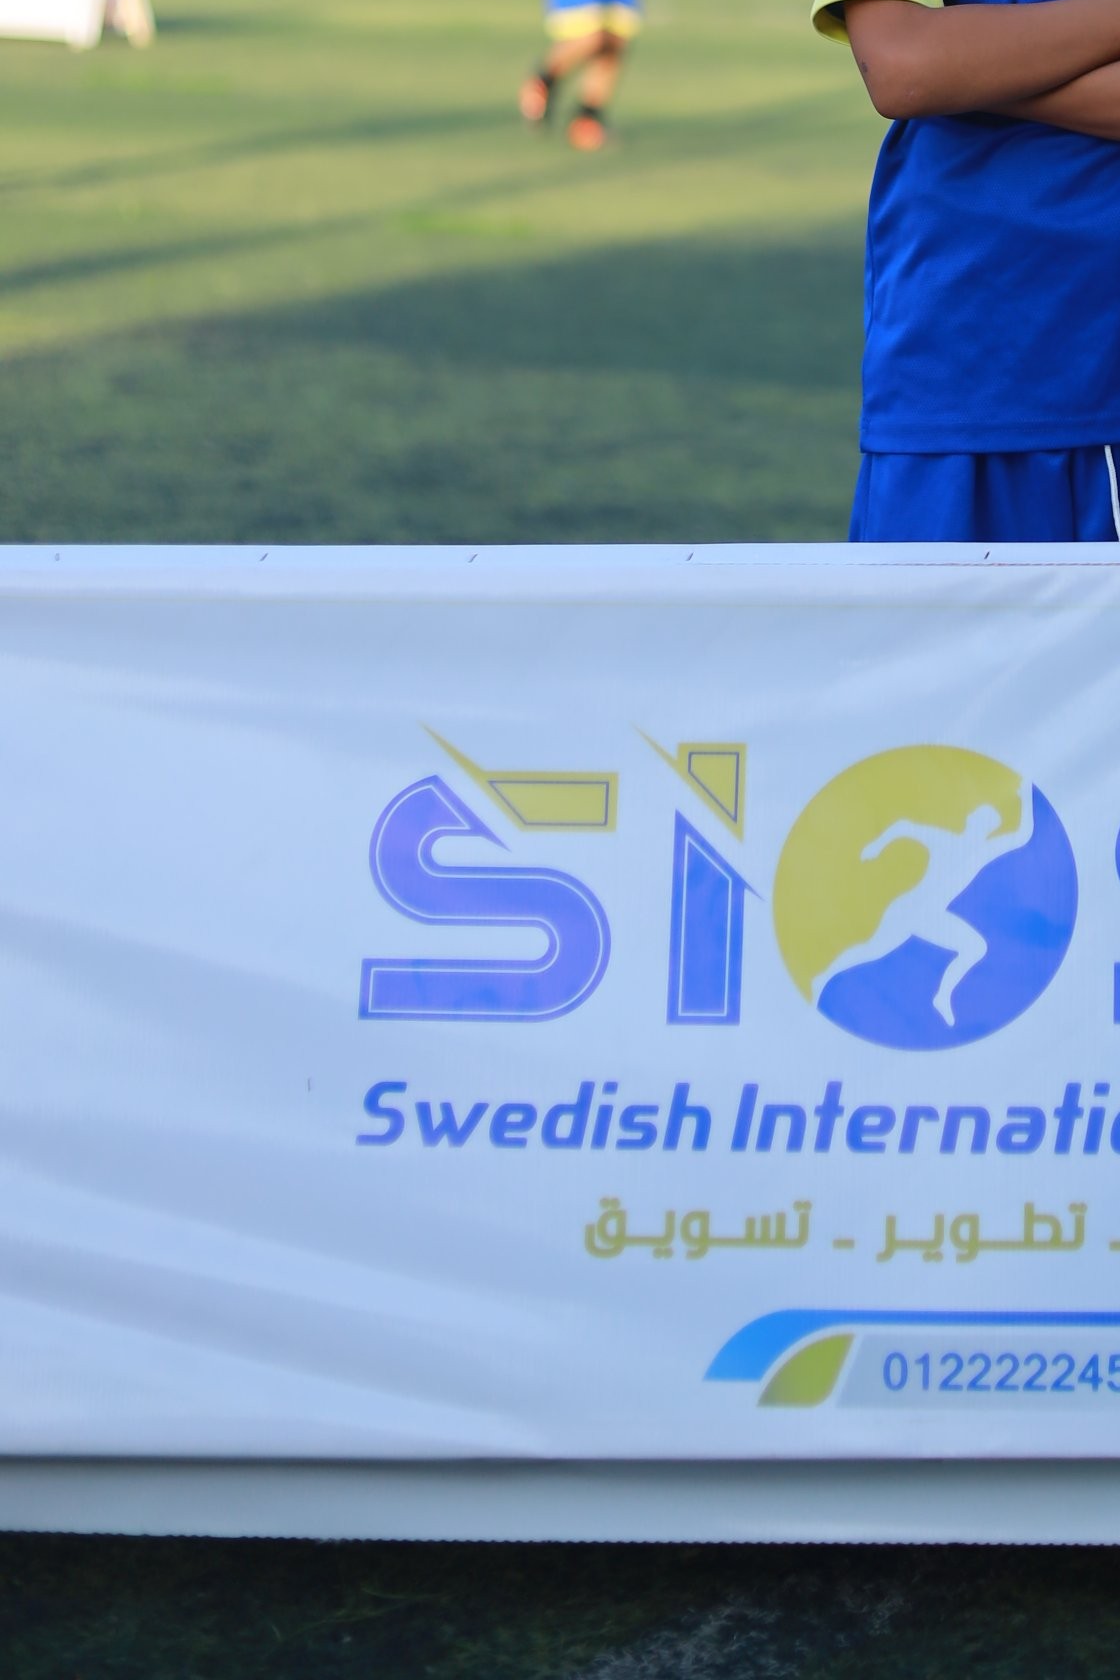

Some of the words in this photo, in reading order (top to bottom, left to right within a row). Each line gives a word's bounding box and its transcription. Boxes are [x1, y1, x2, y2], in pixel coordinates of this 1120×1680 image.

[355, 1080, 712, 1152] Swedish
[584, 1197, 812, 1260] تسويق
[876, 1201, 1087, 1263] تطوير
